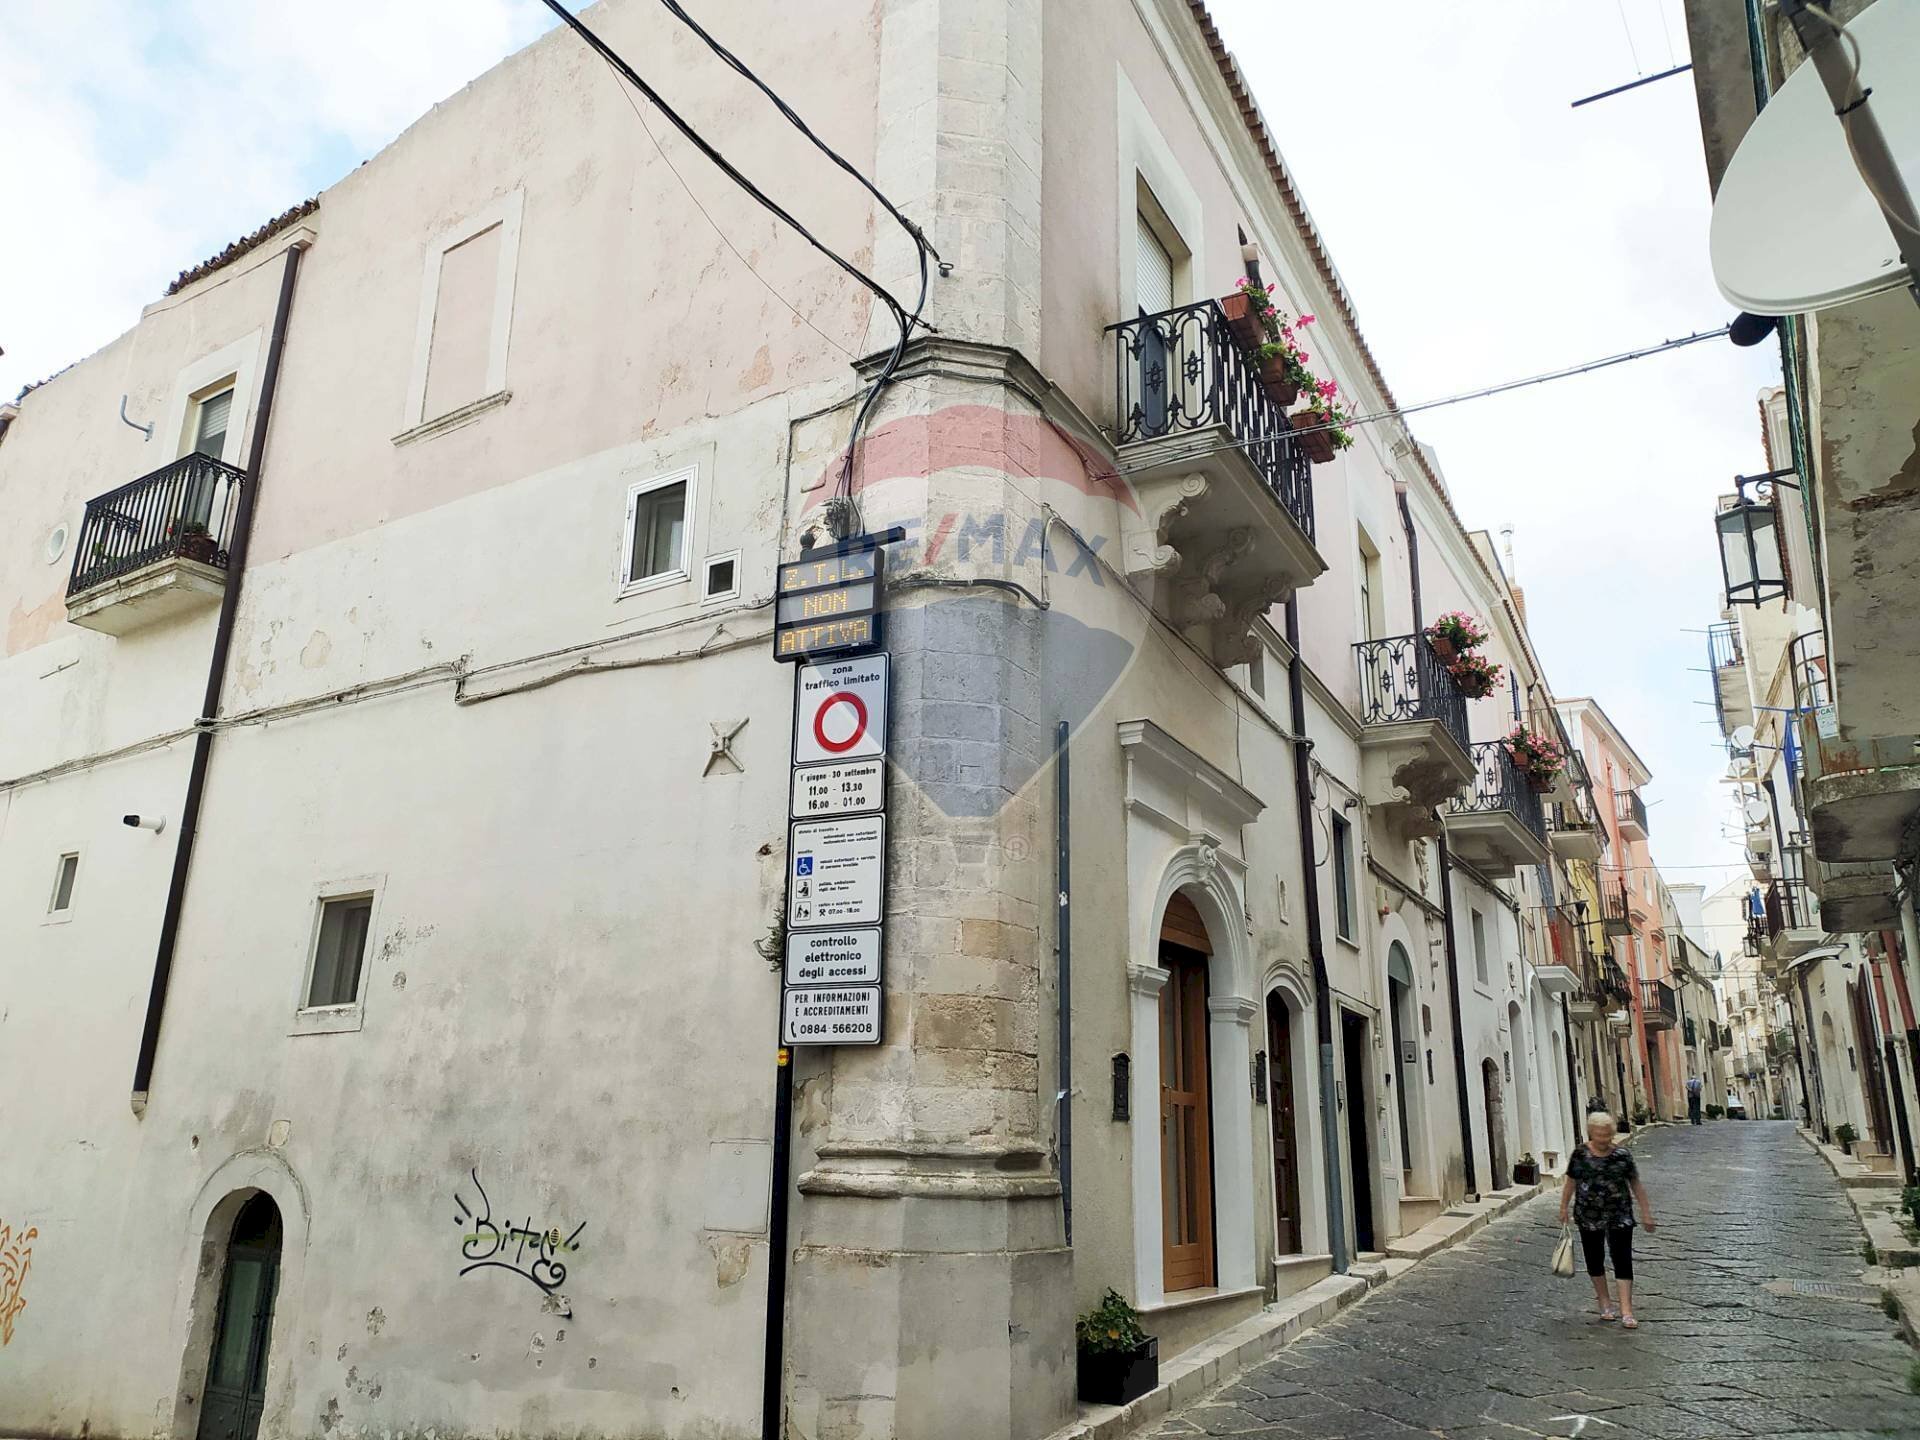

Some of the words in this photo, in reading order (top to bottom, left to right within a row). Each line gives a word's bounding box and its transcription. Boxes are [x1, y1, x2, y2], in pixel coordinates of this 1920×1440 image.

[804, 590, 847, 617] NON
[781, 619, 867, 652] ATTIVA
[832, 665, 853, 675] zona
[805, 679, 840, 691] traffico
[843, 672, 880, 686] limitato
[832, 770, 841, 778] 30
[844, 767, 876, 777] settembre
[809, 785, 829, 796] 11.00
[842, 782, 863, 792] 13.30
[808, 799, 829, 810] 16.00
[843, 796, 866, 807] 01.00
[810, 936, 857, 948] controllo
[804, 951, 862, 963] elettronico
[799, 967, 824, 979] degli
[828, 965, 867, 976] accessi
[794, 994, 809, 1004] PER
[813, 992, 870, 1003] INFORMAZIONI
[795, 1007, 799, 1017] E
[803, 1005, 869, 1016] ACCREDITAMENTI
